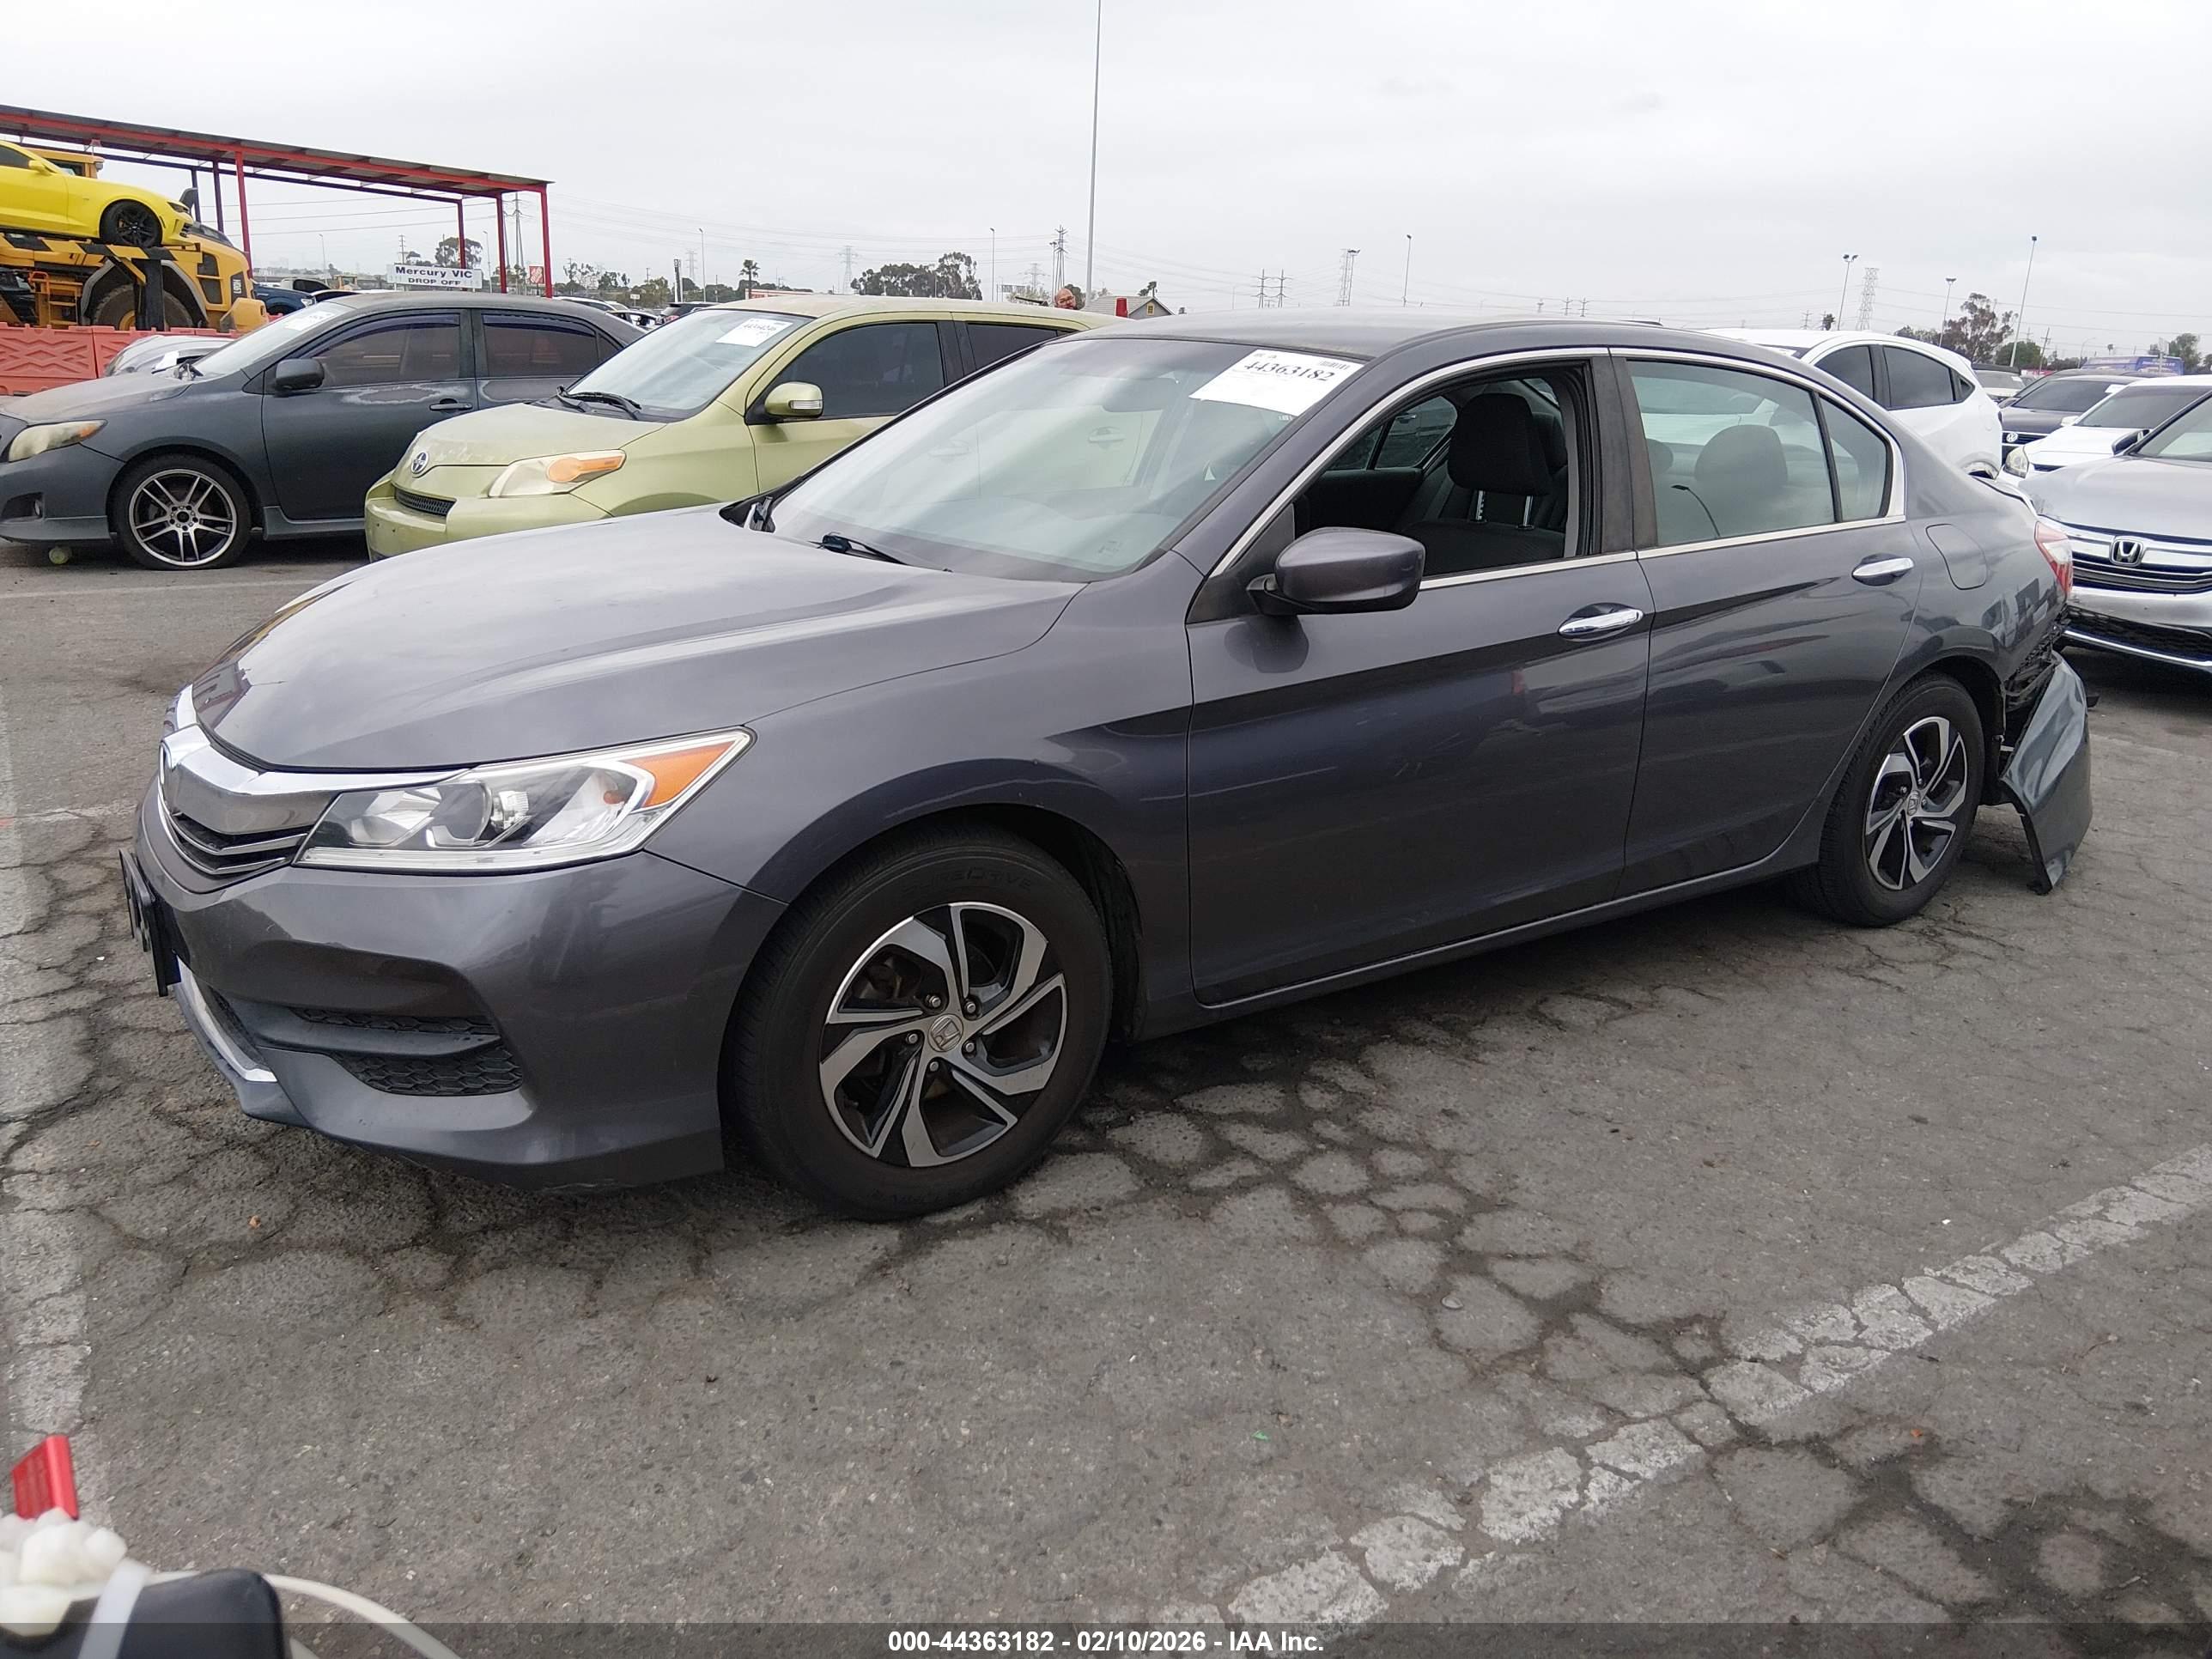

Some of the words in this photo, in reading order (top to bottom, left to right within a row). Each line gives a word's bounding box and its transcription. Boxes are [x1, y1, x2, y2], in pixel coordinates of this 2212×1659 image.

[395, 266, 447, 278] Mercury
[452, 270, 473, 278] VIC
[1243, 361, 1335, 381] 44363182
